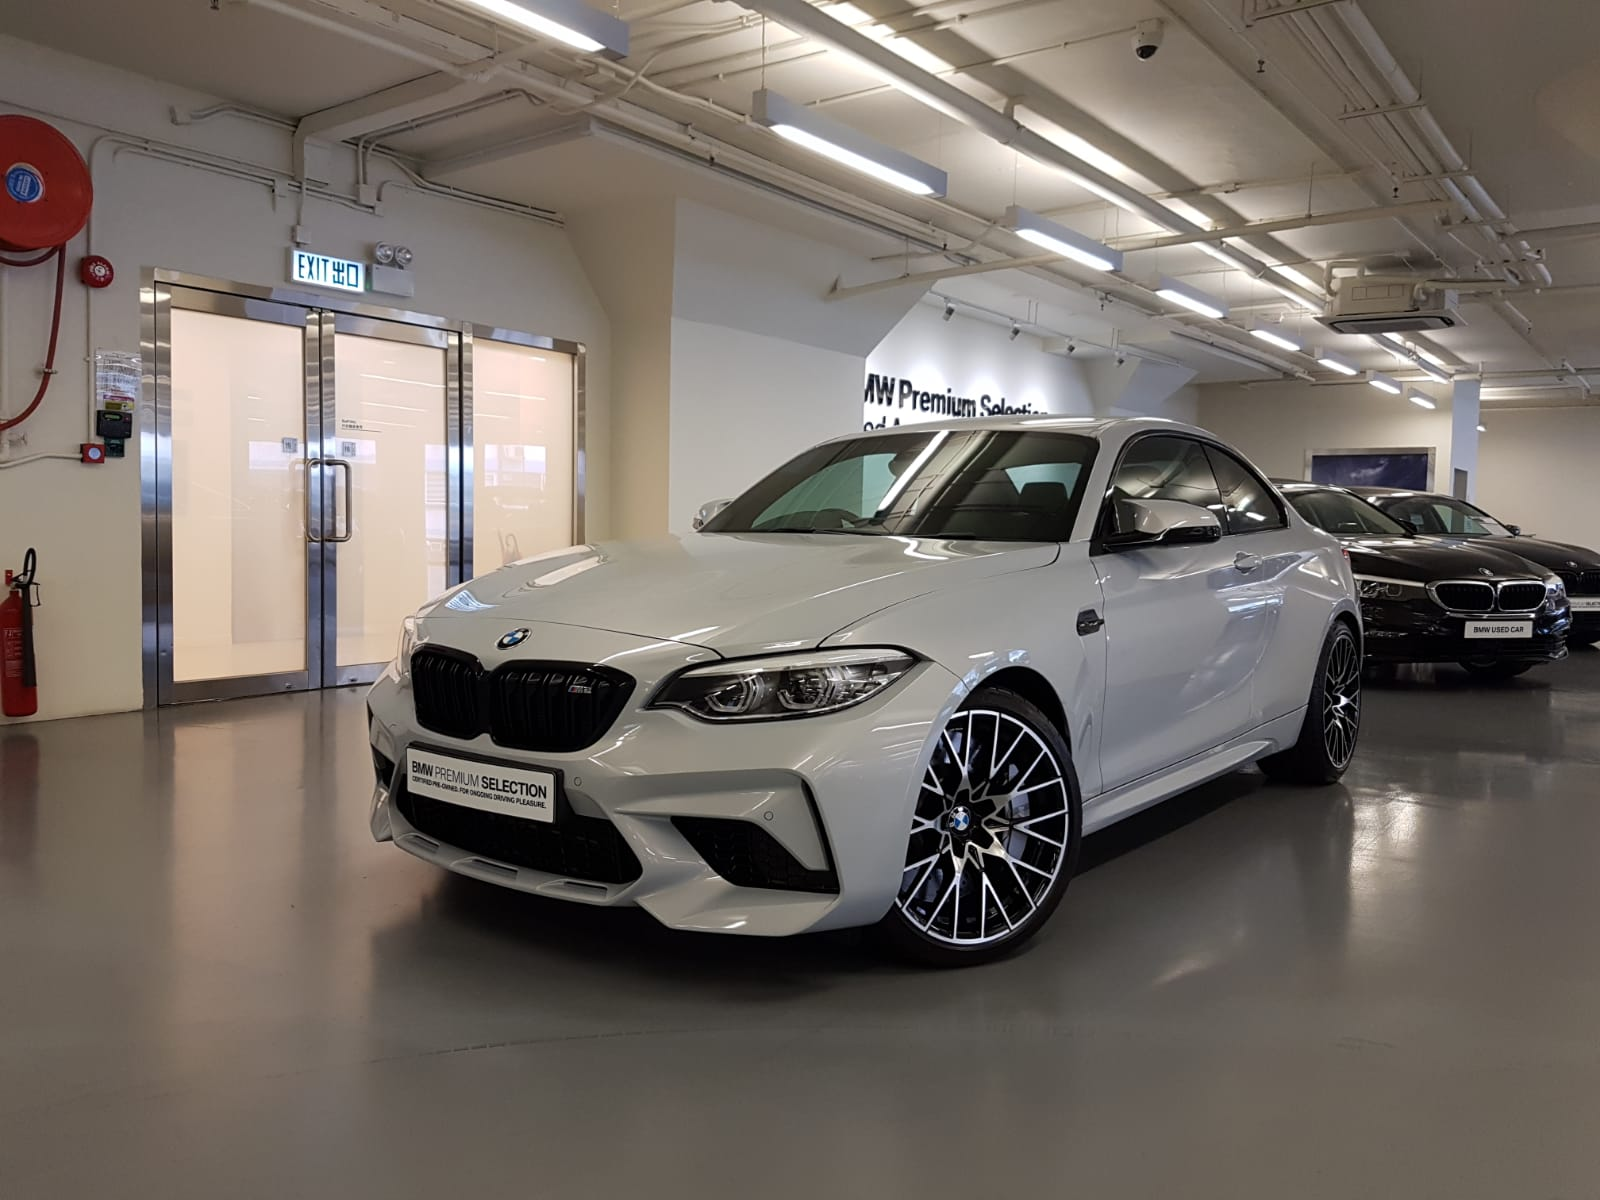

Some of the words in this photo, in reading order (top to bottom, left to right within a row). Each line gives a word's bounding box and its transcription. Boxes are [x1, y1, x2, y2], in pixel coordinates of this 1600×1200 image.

[298, 254, 329, 282] EXIT
[332, 261, 359, 288] 出口
[864, 373, 896, 407] MW
[899, 379, 977, 418] Premium
[412, 760, 434, 777] BMW
[434, 766, 480, 787] PREMIUM
[481, 775, 547, 799] SELECTION
[469, 789, 492, 799] ONGOING
[493, 794, 515, 804] DRIVING
[515, 798, 547, 808] PLEASURE.
